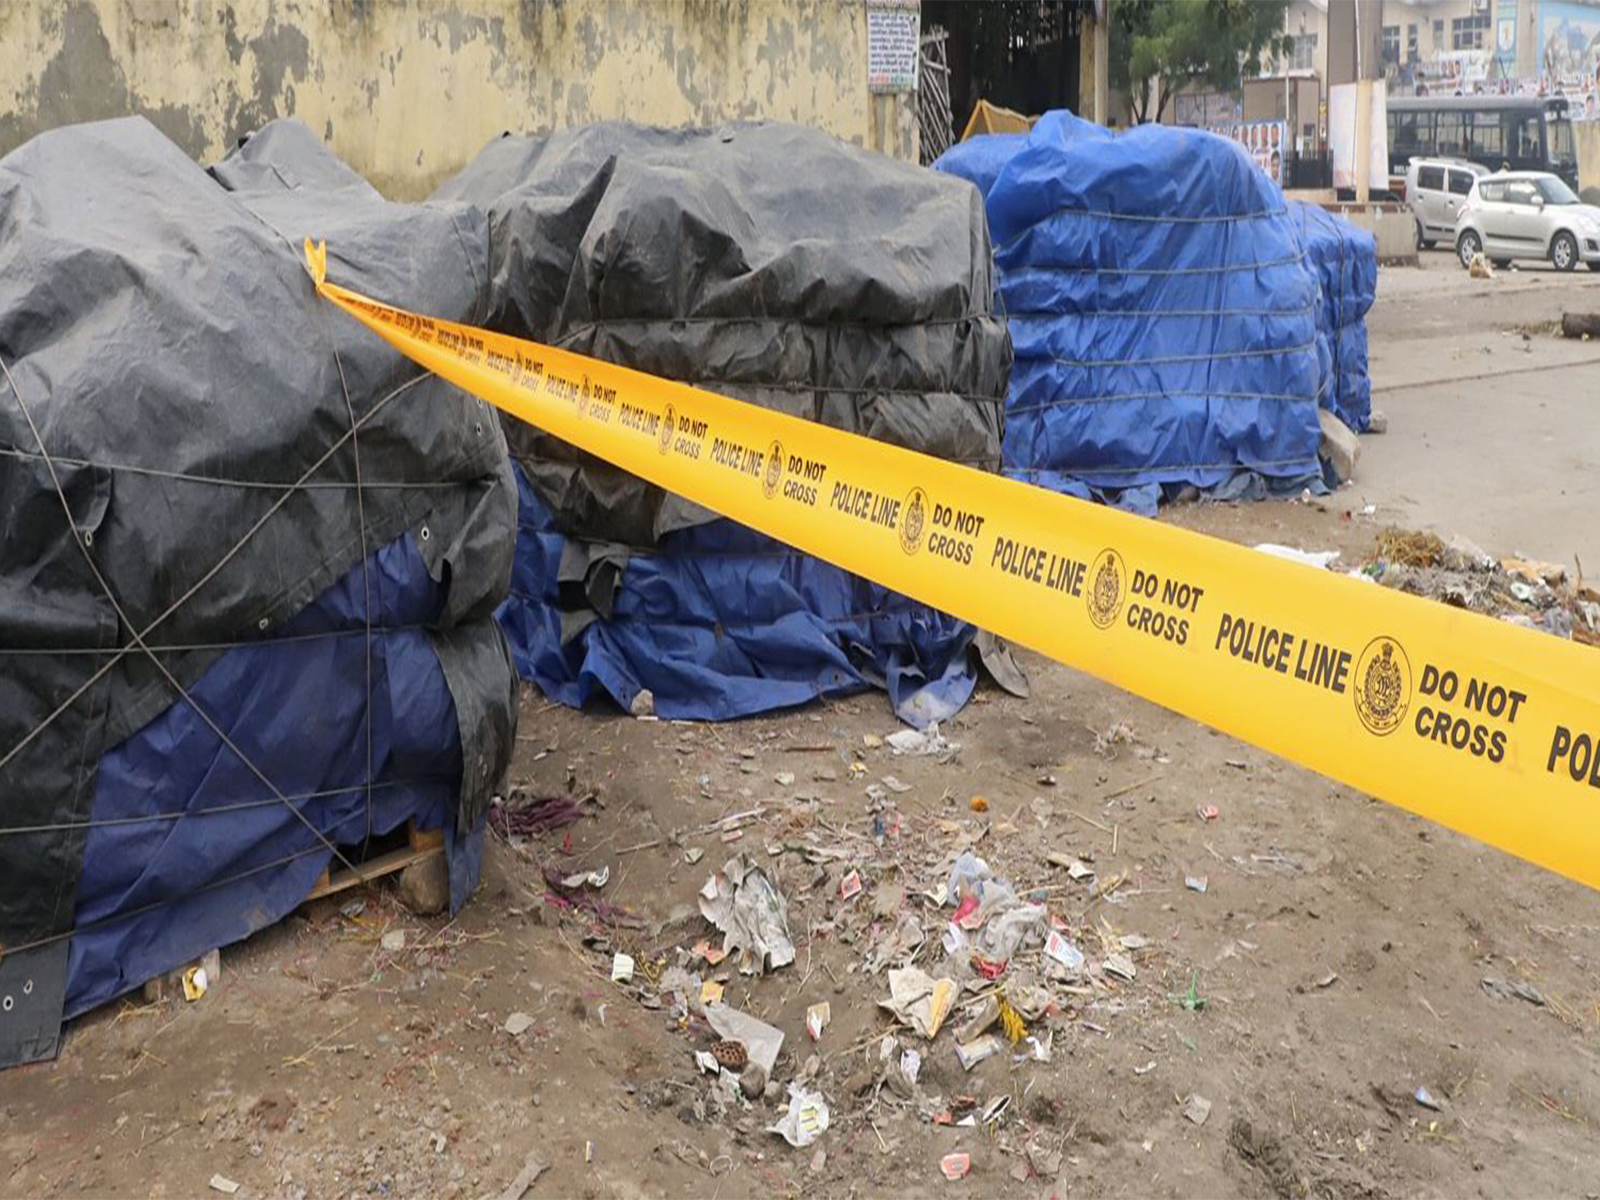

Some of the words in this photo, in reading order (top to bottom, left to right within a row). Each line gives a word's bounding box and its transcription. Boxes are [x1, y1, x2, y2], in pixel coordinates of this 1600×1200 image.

[525, 358, 533, 371] DO
[533, 361, 543, 375] NOT
[544, 374, 566, 398] POLICE
[564, 381, 579, 402] LINE
[593, 384, 602, 399] DO
[603, 388, 617, 405] NOT
[589, 404, 611, 423] CROSS
[619, 402, 644, 431] POLICE
[642, 412, 660, 436] LINE
[678, 415, 691, 433] DO
[691, 420, 708, 439] NOT
[674, 437, 701, 459] CROSS
[710, 438, 742, 470] POLICE
[740, 447, 764, 477] LINE
[788, 455, 803, 475] DO
[804, 462, 827, 482] NOT
[783, 479, 817, 506] CROSS
[830, 481, 872, 520] POLICE
[870, 494, 900, 529] LINE
[932, 503, 952, 528] DO
[954, 513, 984, 538] NOT
[928, 532, 973, 565] CROSS
[991, 537, 1047, 583] POLICE
[1046, 555, 1087, 598] LINE
[1131, 570, 1158, 598] DO
[1162, 579, 1204, 612] NOT
[1127, 603, 1190, 646] CROSS
[1215, 613, 1294, 673] POLICE
[1294, 639, 1352, 694] LINE
[1419, 664, 1458, 702] DO
[1464, 678, 1527, 724] NOT
[1415, 706, 1507, 763] CROSS
[1547, 725, 1600, 789] POL
